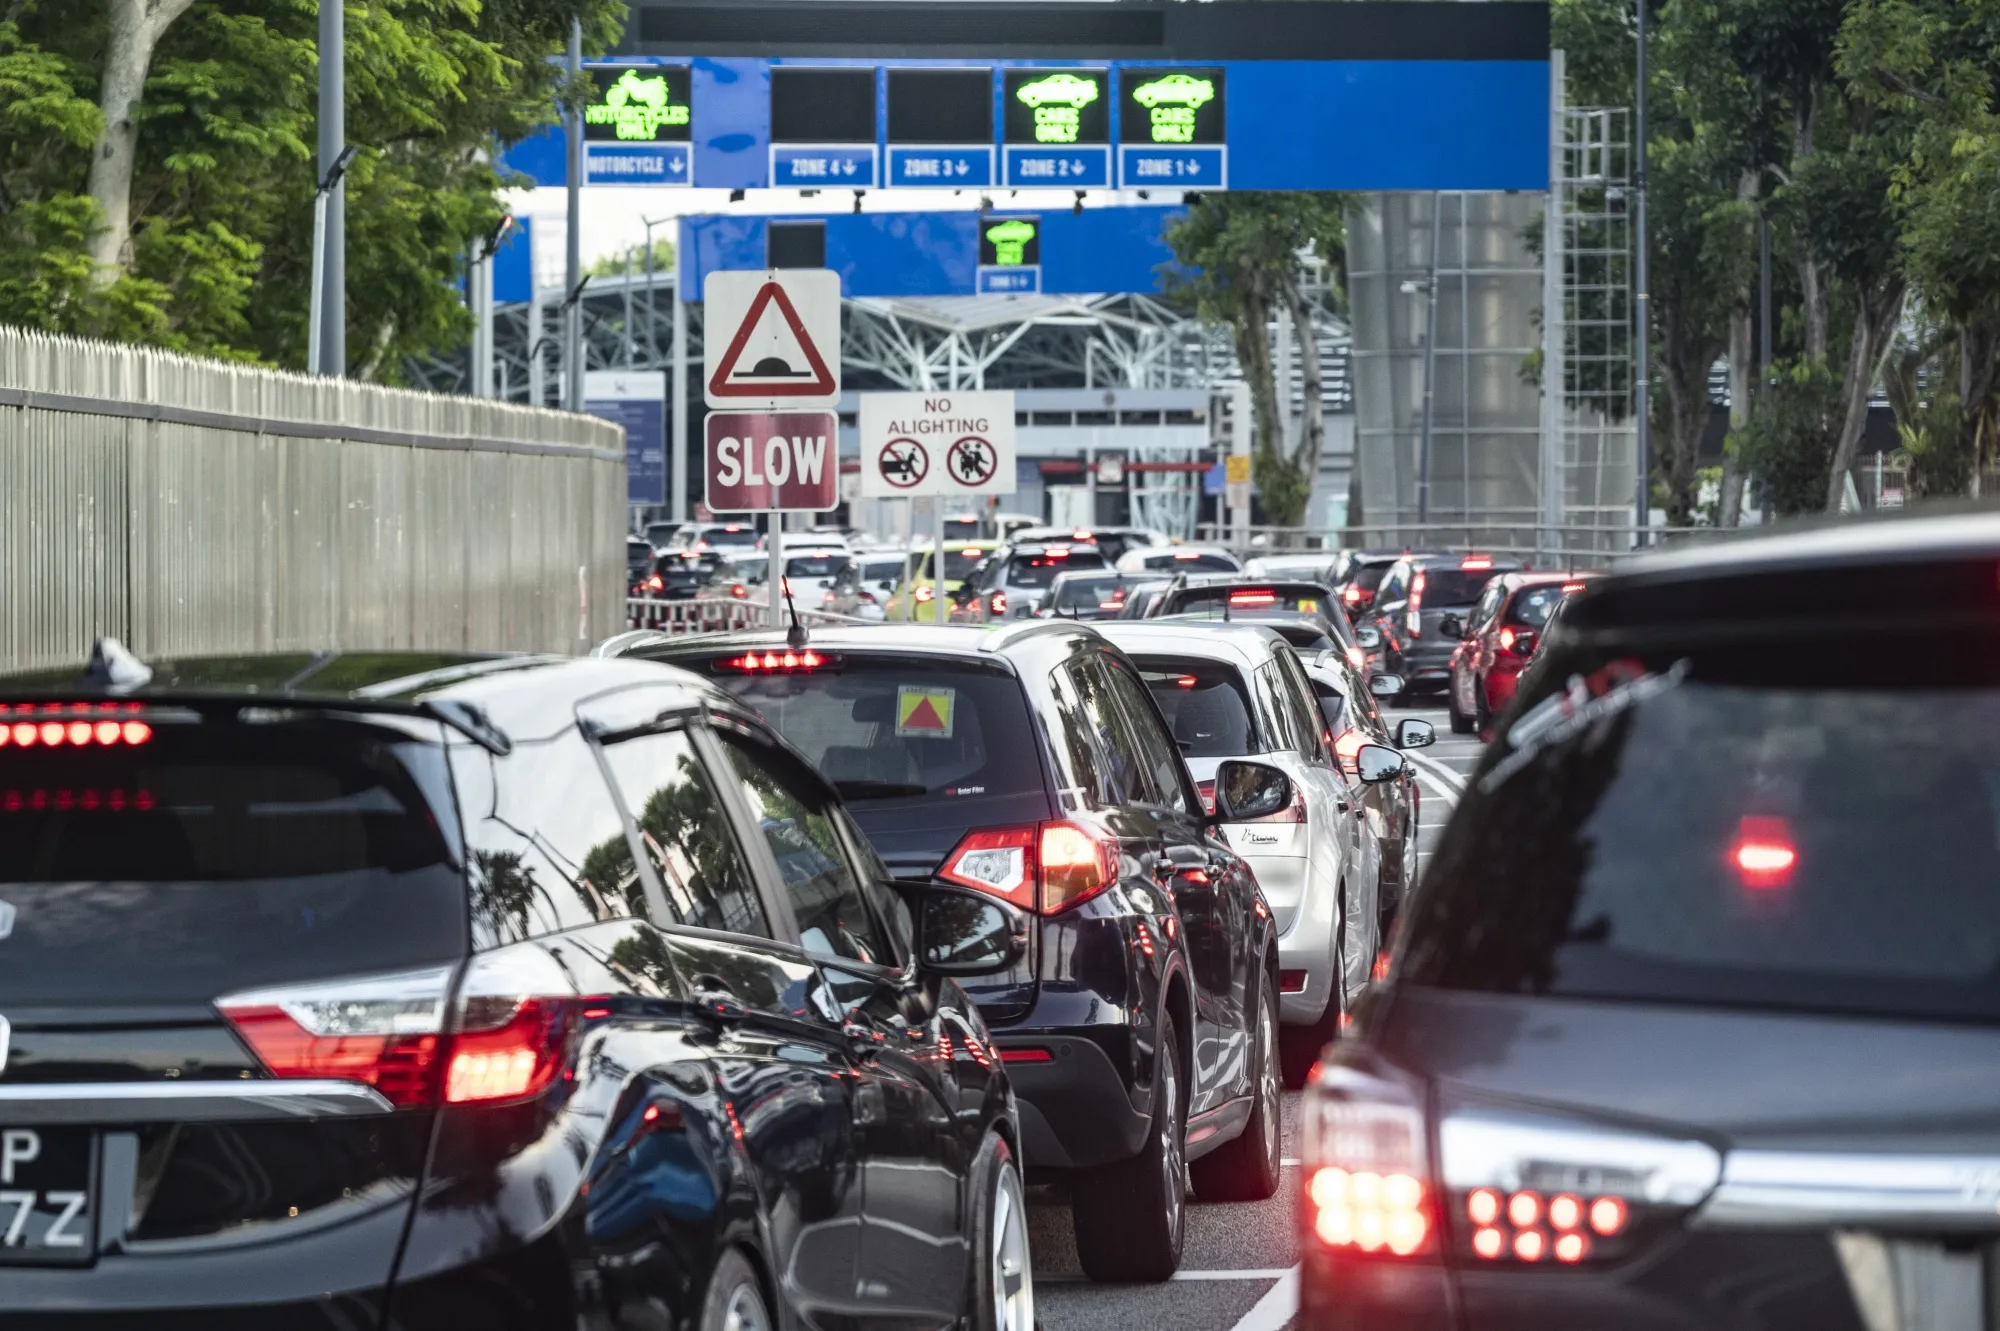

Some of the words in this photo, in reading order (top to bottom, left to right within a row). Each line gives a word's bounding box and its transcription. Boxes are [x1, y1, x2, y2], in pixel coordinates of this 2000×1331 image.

[586, 105, 689, 124] MOTORCYCLES
[1035, 107, 1079, 123] CARS
[1151, 107, 1195, 124] CARS
[616, 122, 657, 140] ONLY
[1035, 124, 1079, 142] ONLY
[1151, 124, 1195, 142] ONLY
[588, 156, 664, 174] MOTORCYCLE
[791, 159, 827, 176] ZONE
[830, 159, 840, 176] 4
[904, 159, 940, 176] ZONE
[943, 159, 953, 177] 3
[1020, 159, 1056, 176] ZONE
[1058, 159, 1068, 176] 2
[1136, 159, 1173, 176] ZONE
[1176, 159, 1184, 176] 1
[925, 398, 951, 413] NO
[888, 418, 989, 435] ALIGHTING
[716, 436, 827, 487] SLOW
[2, 1129, 40, 1183] P
[0, 1190, 86, 1247] 7Z
